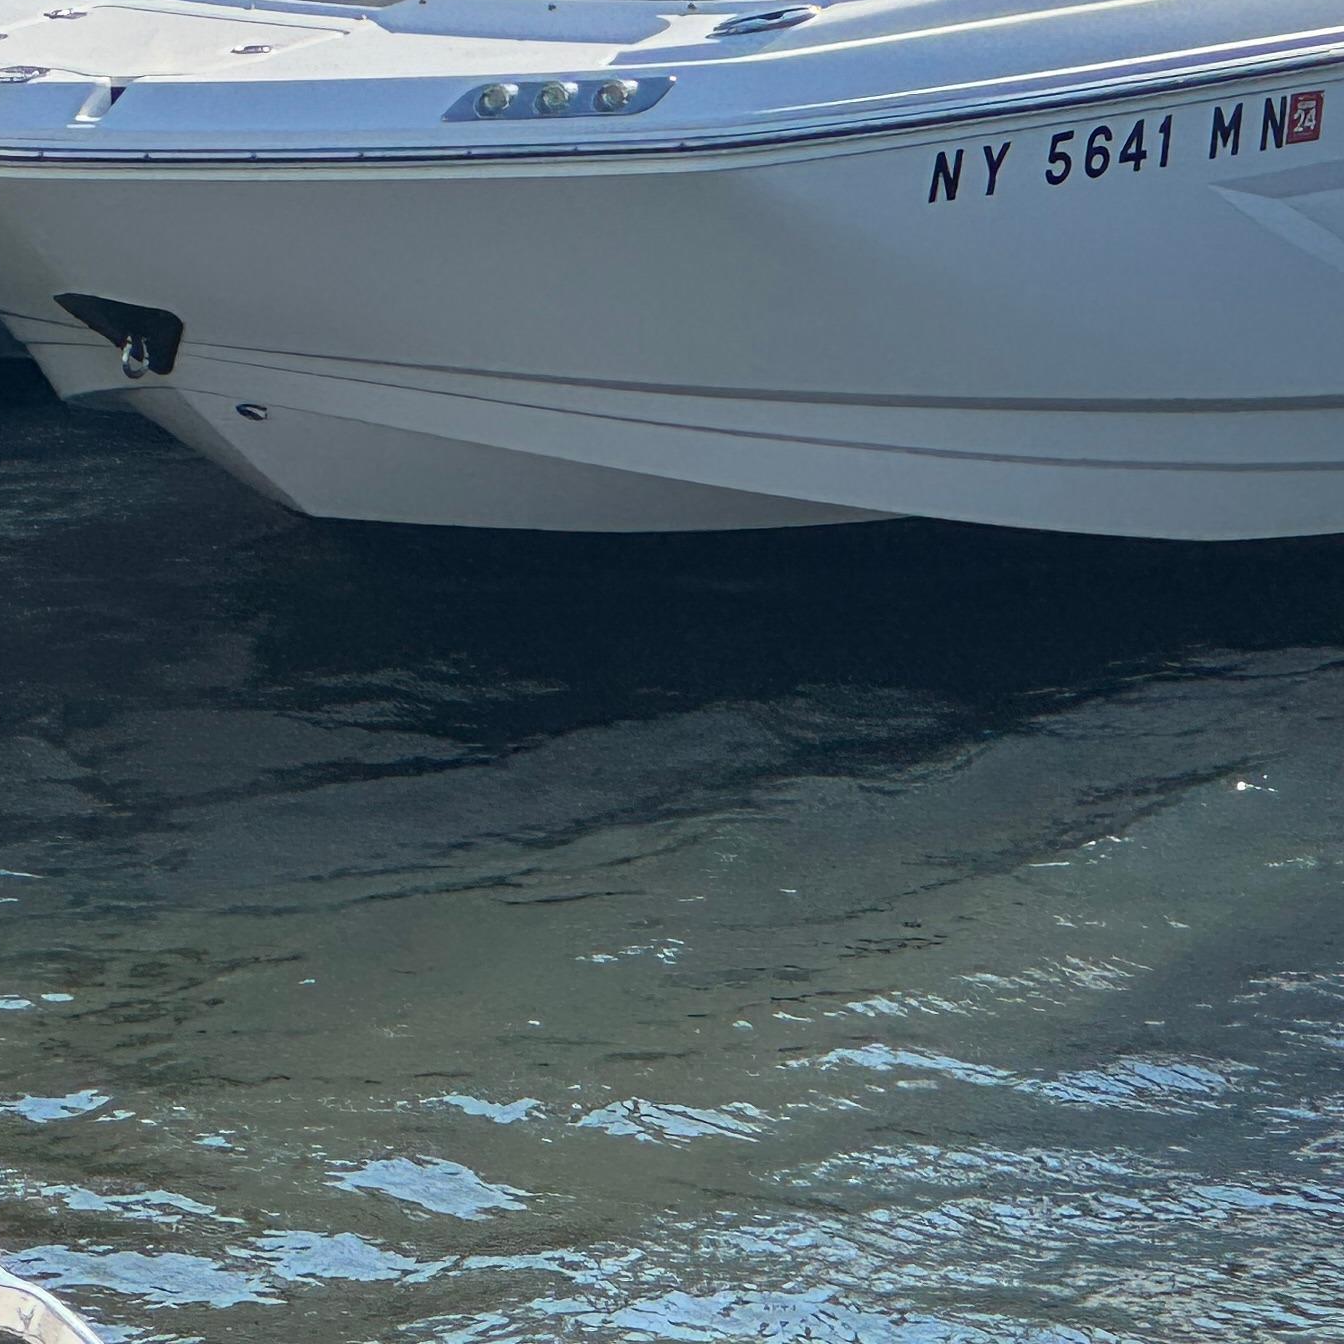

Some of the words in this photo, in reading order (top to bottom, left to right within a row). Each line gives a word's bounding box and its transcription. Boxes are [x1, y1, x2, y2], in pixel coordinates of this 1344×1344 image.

[928, 141, 1012, 203] NY
[1045, 114, 1174, 186] 5641
[1208, 95, 1288, 159] MN
[1293, 108, 1317, 132] 24
